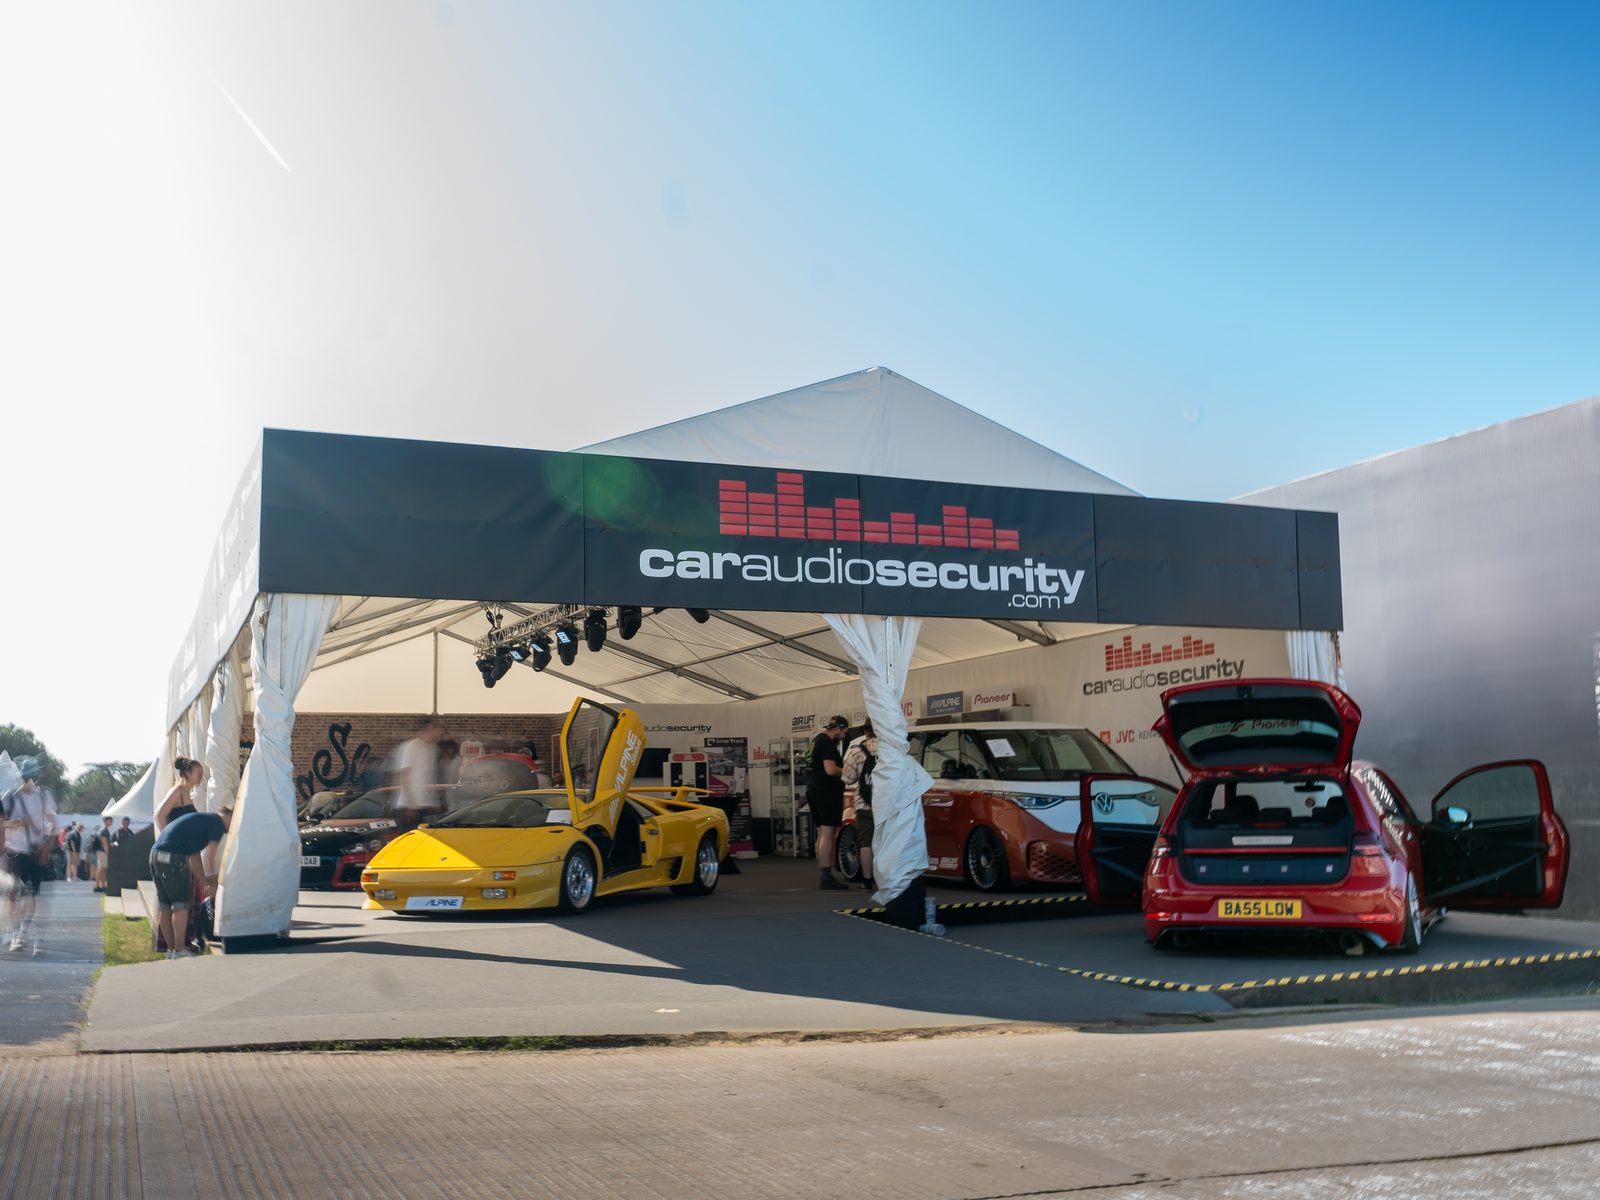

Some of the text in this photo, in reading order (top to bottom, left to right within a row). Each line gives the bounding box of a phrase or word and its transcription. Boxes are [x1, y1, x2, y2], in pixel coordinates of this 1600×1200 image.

[639, 547, 1085, 605] caraudiosecurity
[1007, 592, 1061, 609] .com
[1082, 658, 1245, 696] caraudiosecurity
[973, 693, 1010, 705] Pioneer
[901, 702, 913, 717] VC
[424, 899, 460, 907] ALPINE
[1265, 902, 1294, 917] LOW
